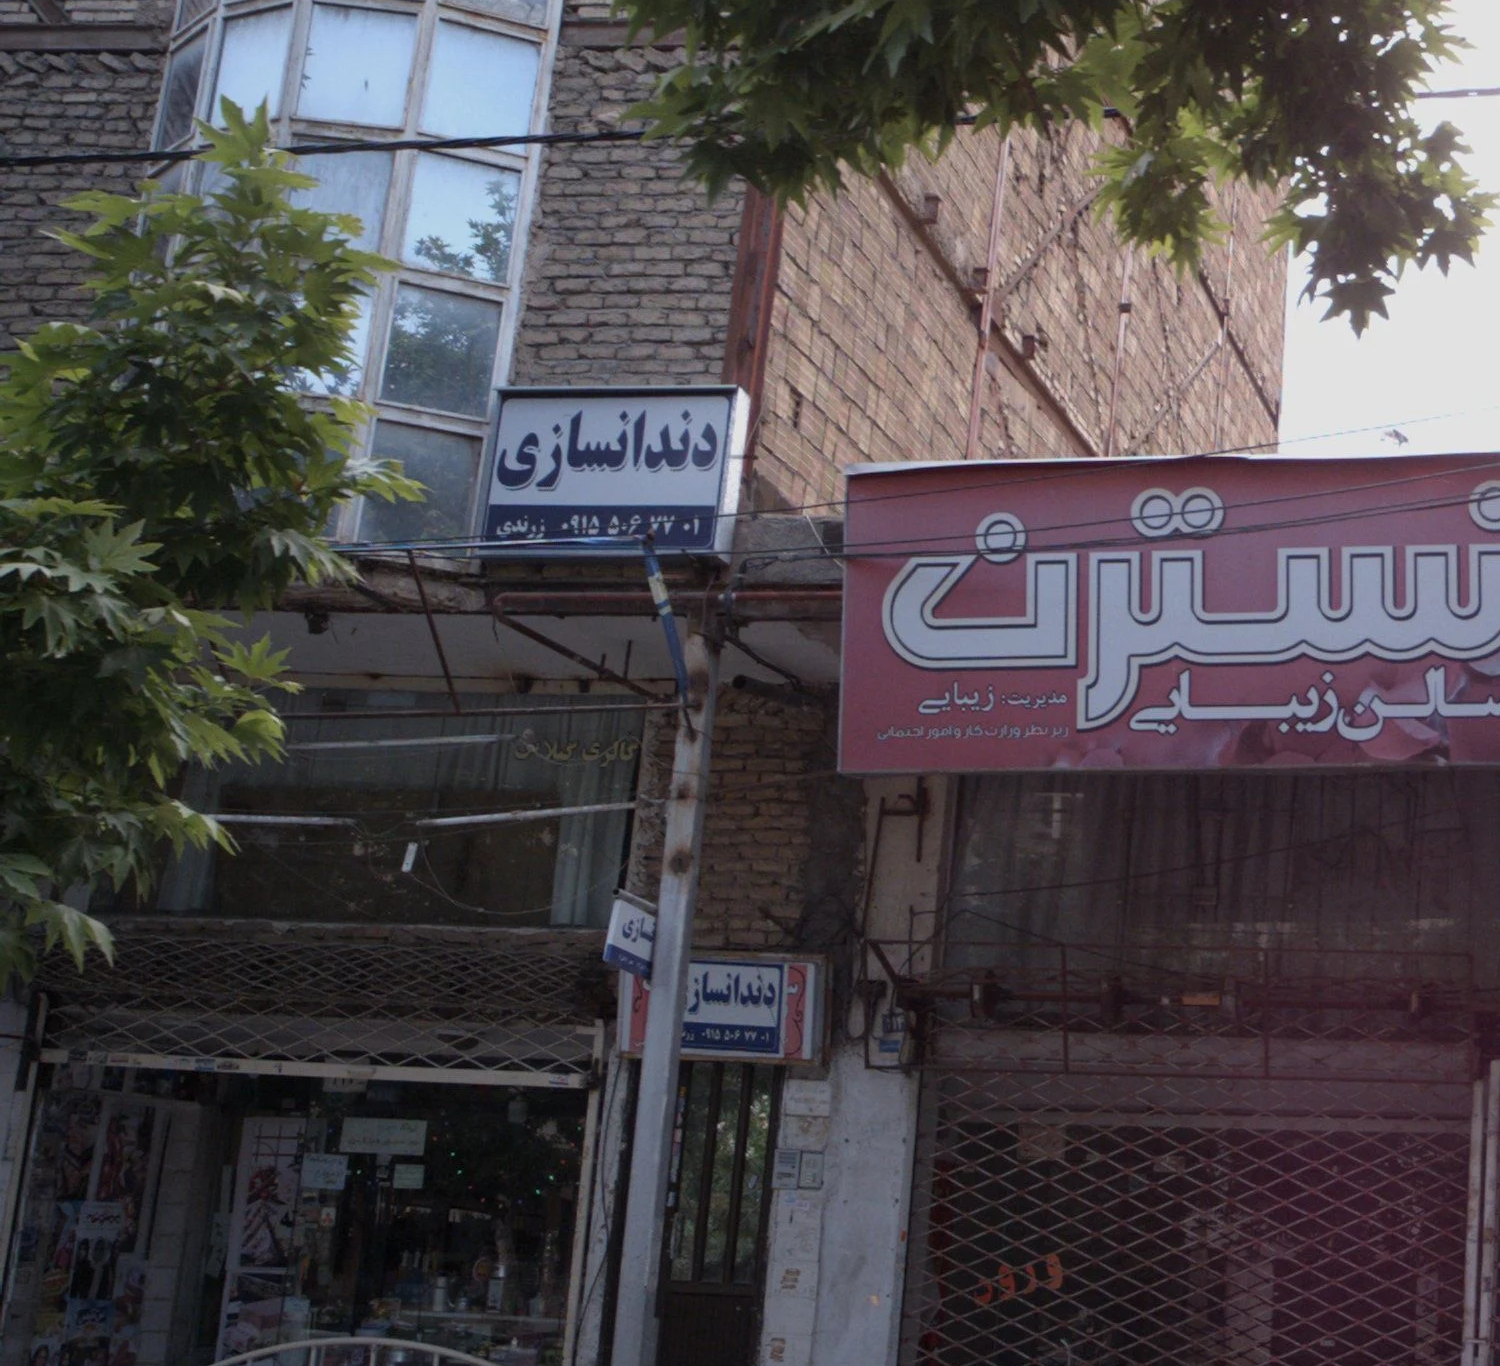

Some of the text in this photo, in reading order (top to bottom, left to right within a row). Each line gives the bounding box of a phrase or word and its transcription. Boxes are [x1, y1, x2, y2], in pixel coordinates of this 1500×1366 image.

[496, 410, 718, 491] دندانسازی
[1129, 669, 1339, 735] زیبایی
[687, 971, 776, 1015] دندانساز
